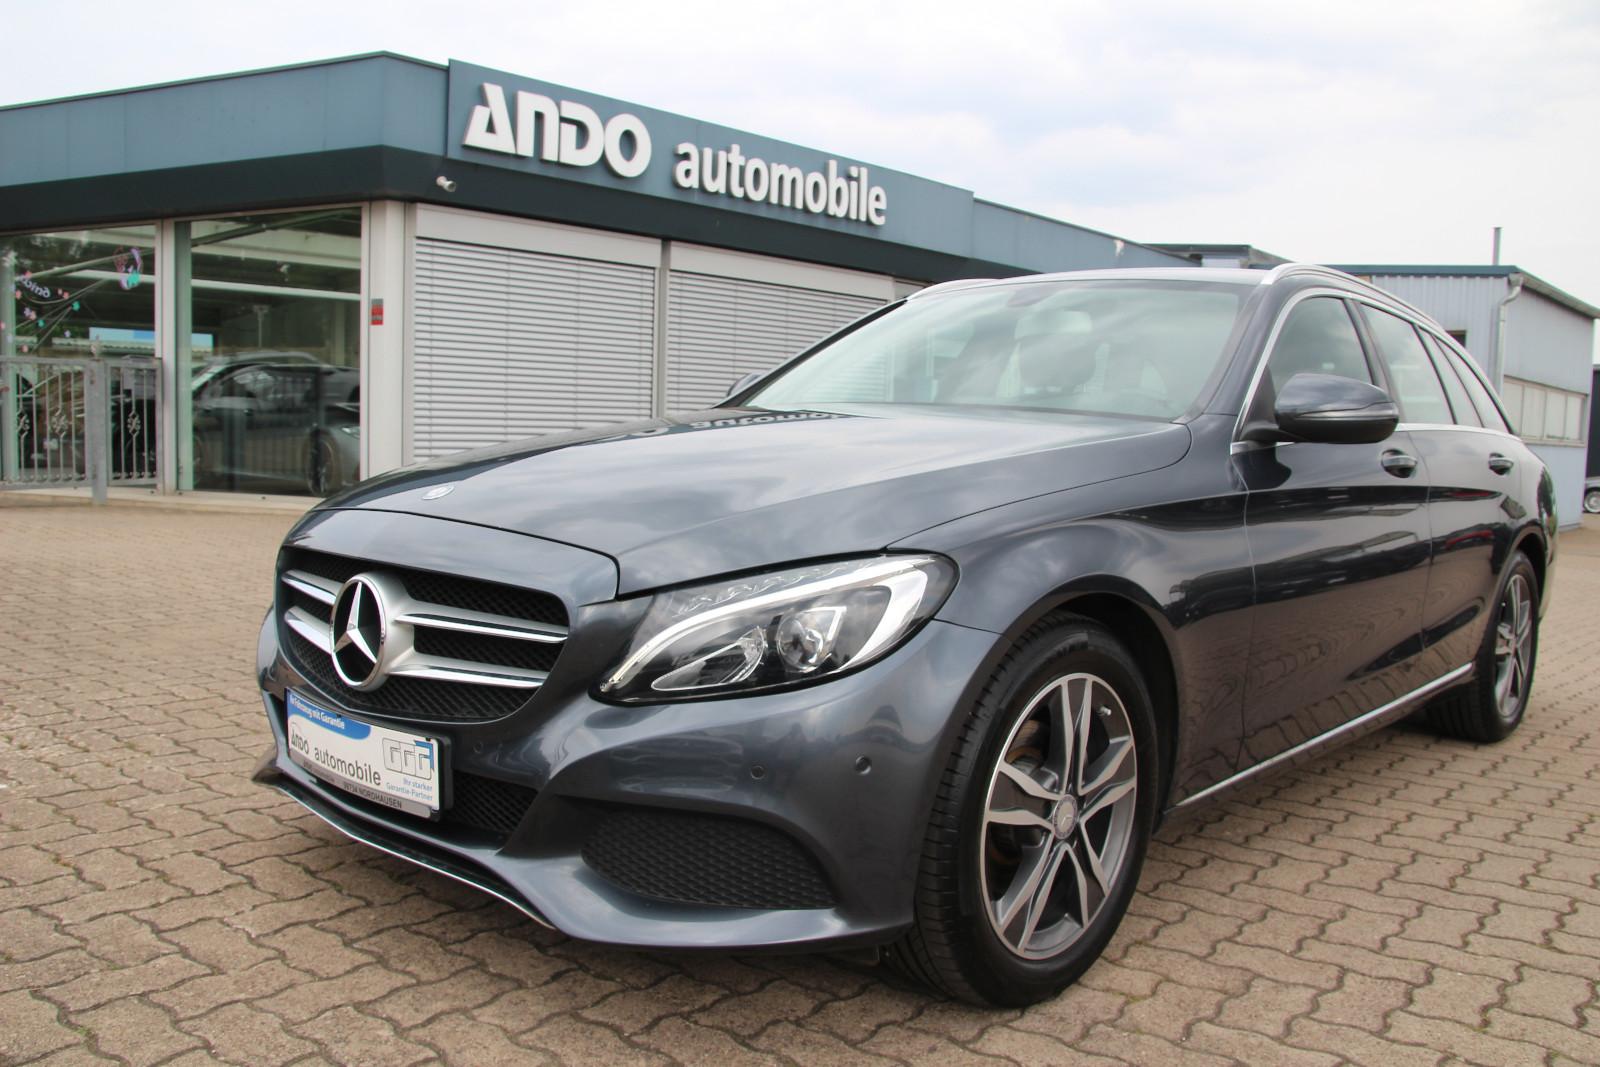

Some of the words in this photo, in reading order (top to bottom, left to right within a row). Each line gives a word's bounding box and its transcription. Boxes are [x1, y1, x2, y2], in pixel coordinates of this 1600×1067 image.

[463, 82, 652, 179] ANDO
[672, 143, 888, 227] automobile
[320, 711, 345, 730] Garantie
[314, 746, 382, 786] automobile
[358, 785, 403, 809] NORDHAUSEN
